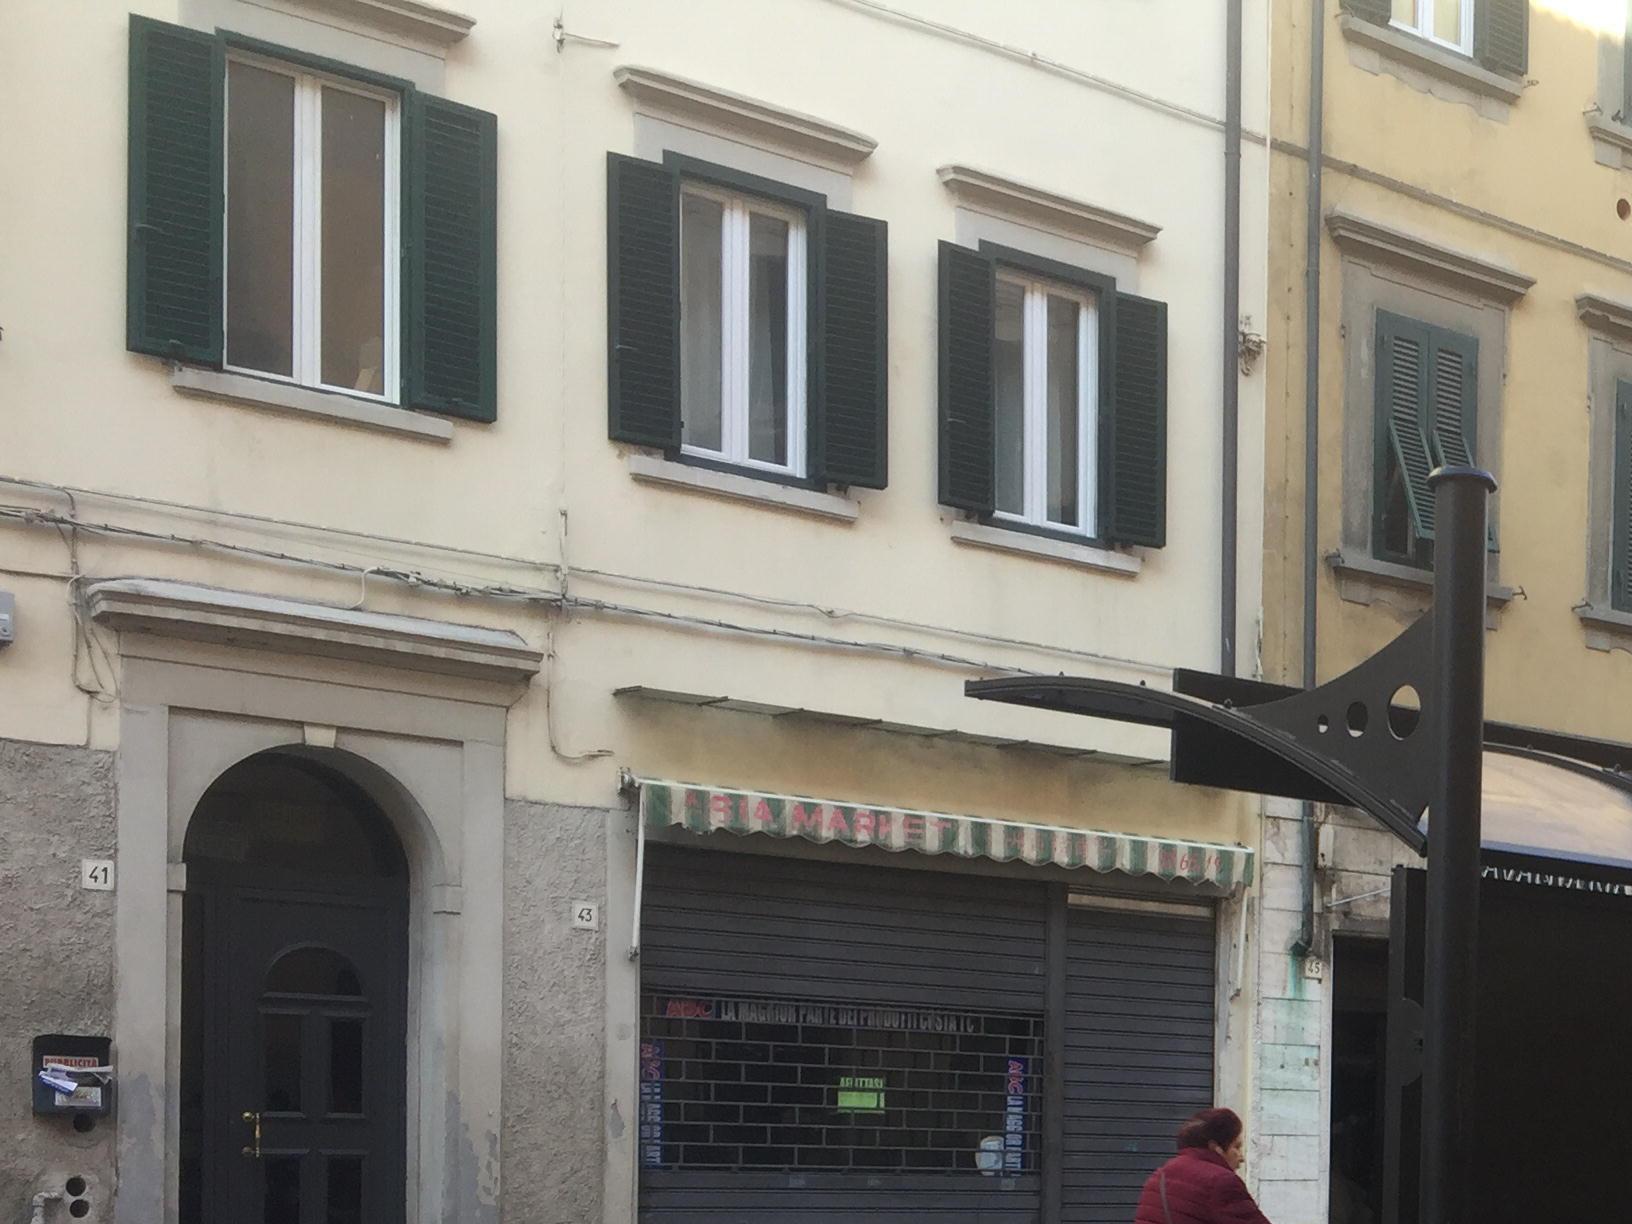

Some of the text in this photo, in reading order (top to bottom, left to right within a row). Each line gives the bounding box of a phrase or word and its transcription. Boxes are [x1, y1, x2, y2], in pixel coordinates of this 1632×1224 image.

[88, 865, 109, 885] 41
[577, 907, 593, 922] 43
[1307, 960, 1321, 974] 45
